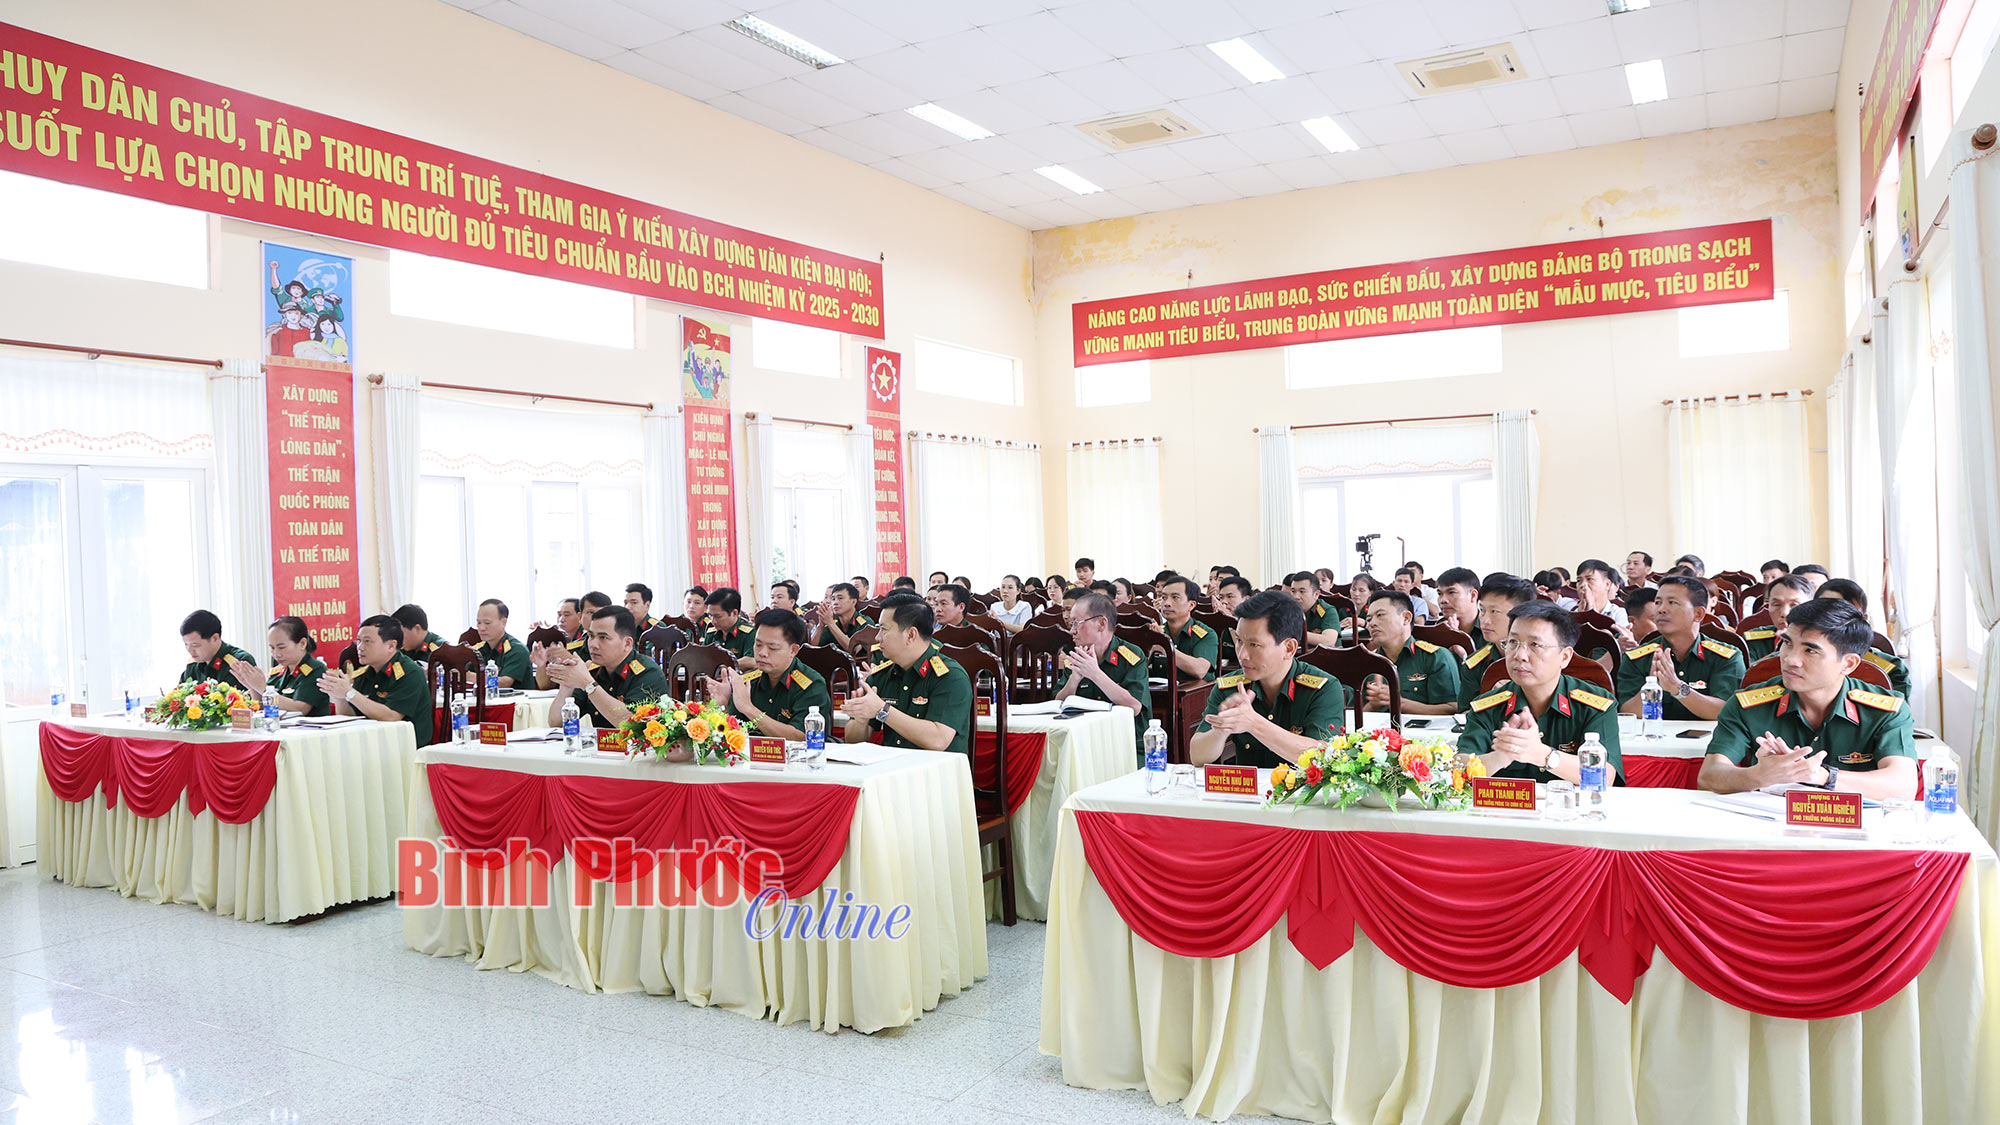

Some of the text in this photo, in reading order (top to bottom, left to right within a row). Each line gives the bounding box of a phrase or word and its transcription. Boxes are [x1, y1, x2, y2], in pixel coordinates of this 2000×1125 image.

[81, 71, 158, 125] DÂN
[170, 96, 246, 151] CHỦ,
[254, 117, 312, 163] TẬP
[320, 136, 410, 187] TRUNG
[416, 160, 455, 198] TRÍ
[461, 171, 509, 215] TUỆ,
[515, 186, 574, 226] THAM
[579, 203, 612, 235] GIA
[616, 207, 628, 238] Ý
[632, 214, 674, 250] KIẾN
[678, 226, 709, 258] XÂY
[713, 237, 755, 270] DỰNG
[758, 246, 787, 277] VĂN
[790, 257, 822, 287] KIỆN
[824, 267, 846, 293] ĐẠI
[848, 267, 872, 297] HỘI;
[0, 107, 82, 162] UỐT
[95, 131, 164, 183] LỰA
[174, 151, 264, 204] CHỌN
[274, 174, 373, 226] NHỮNG
[381, 200, 458, 243] NGƯỜI
[465, 212, 496, 251] ĐỦ
[501, 225, 548, 261] TIÊU
[554, 237, 621, 276] CHUẨN
[625, 248, 661, 284] BẦU
[665, 259, 698, 292] VÀO
[702, 269, 735, 300] BCH
[738, 276, 785, 312] NHIỆM
[789, 288, 806, 315] KỲ
[809, 292, 841, 320] 2025
[851, 301, 880, 328] 2030
[1088, 237, 1752, 329] NÂNG CAO NĂNG LỰC LÃNH ĐẠO, SỨC CHIẾN ĐẤU, XÂY DỰNG ĐẢNG BỘ TRONG SẠCH
[1083, 332, 1119, 356] VỮNG
[1123, 331, 1164, 353] MẠNH
[1168, 326, 1198, 346] TIÊU
[1202, 318, 1240, 342] BIỂU,
[1243, 313, 1293, 338] TRUNG
[1297, 308, 1340, 331] ĐOÀN
[1345, 301, 1388, 328] VỮNG
[1392, 303, 1443, 325] MẠNH
[1448, 294, 1493, 317] TOÀN
[1497, 290, 1539, 314] DIỆN
[1602, 280, 1650, 304] MỰC,
[1655, 272, 1697, 296] TIÊU
[282, 384, 338, 406] XÂY DỰNG
[311, 413, 340, 433] TRẬN
[280, 437, 311, 455] LÒNG
[288, 464, 340, 485] THẾ TRẬN
[279, 490, 350, 510] QUỐC PHÒNG
[288, 519, 344, 536] TOÀN DÂN
[280, 544, 350, 565] VÀ THẾ TRẬN
[293, 574, 340, 590] AN NINH
[288, 598, 347, 617] NHÂN DÂN
[1478, 788, 1494, 798] PHAN
[1495, 789, 1514, 799] THANH
[1792, 800, 1815, 813] NGUYỄN
[1816, 801, 1832, 814] XUÂN
